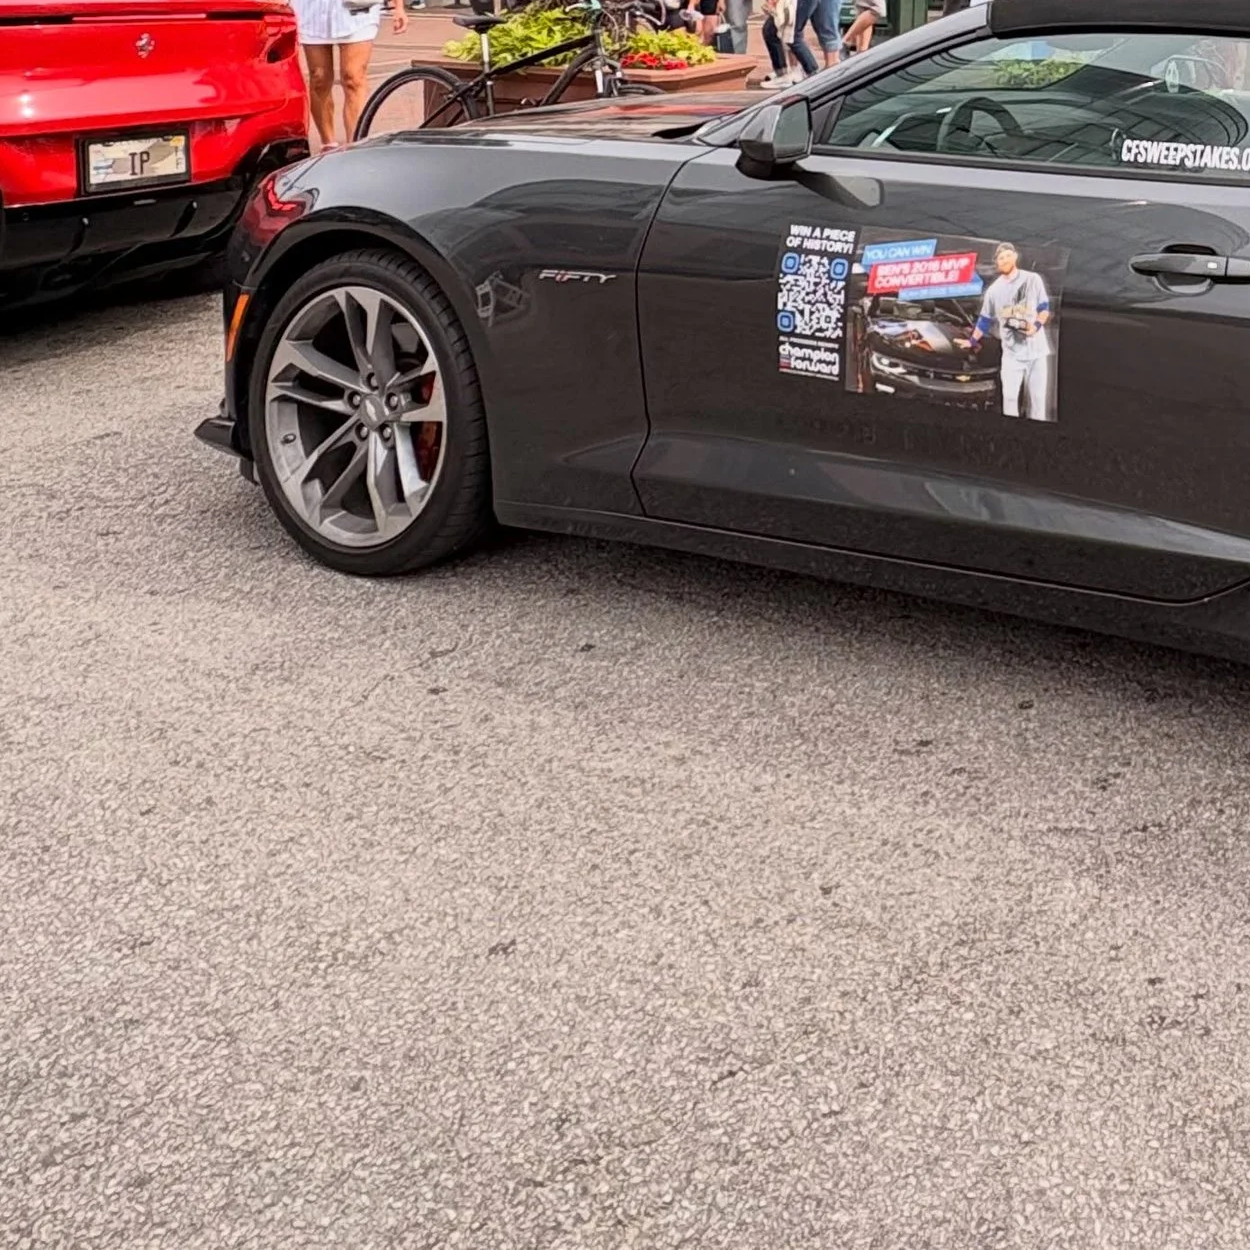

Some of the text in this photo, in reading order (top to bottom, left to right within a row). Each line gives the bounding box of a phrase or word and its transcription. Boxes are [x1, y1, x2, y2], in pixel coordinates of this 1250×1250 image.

[790, 224, 856, 242] WIN A PIECE
[786, 236, 854, 254] OF HISTORY!
[539, 269, 617, 284] FIFTY
